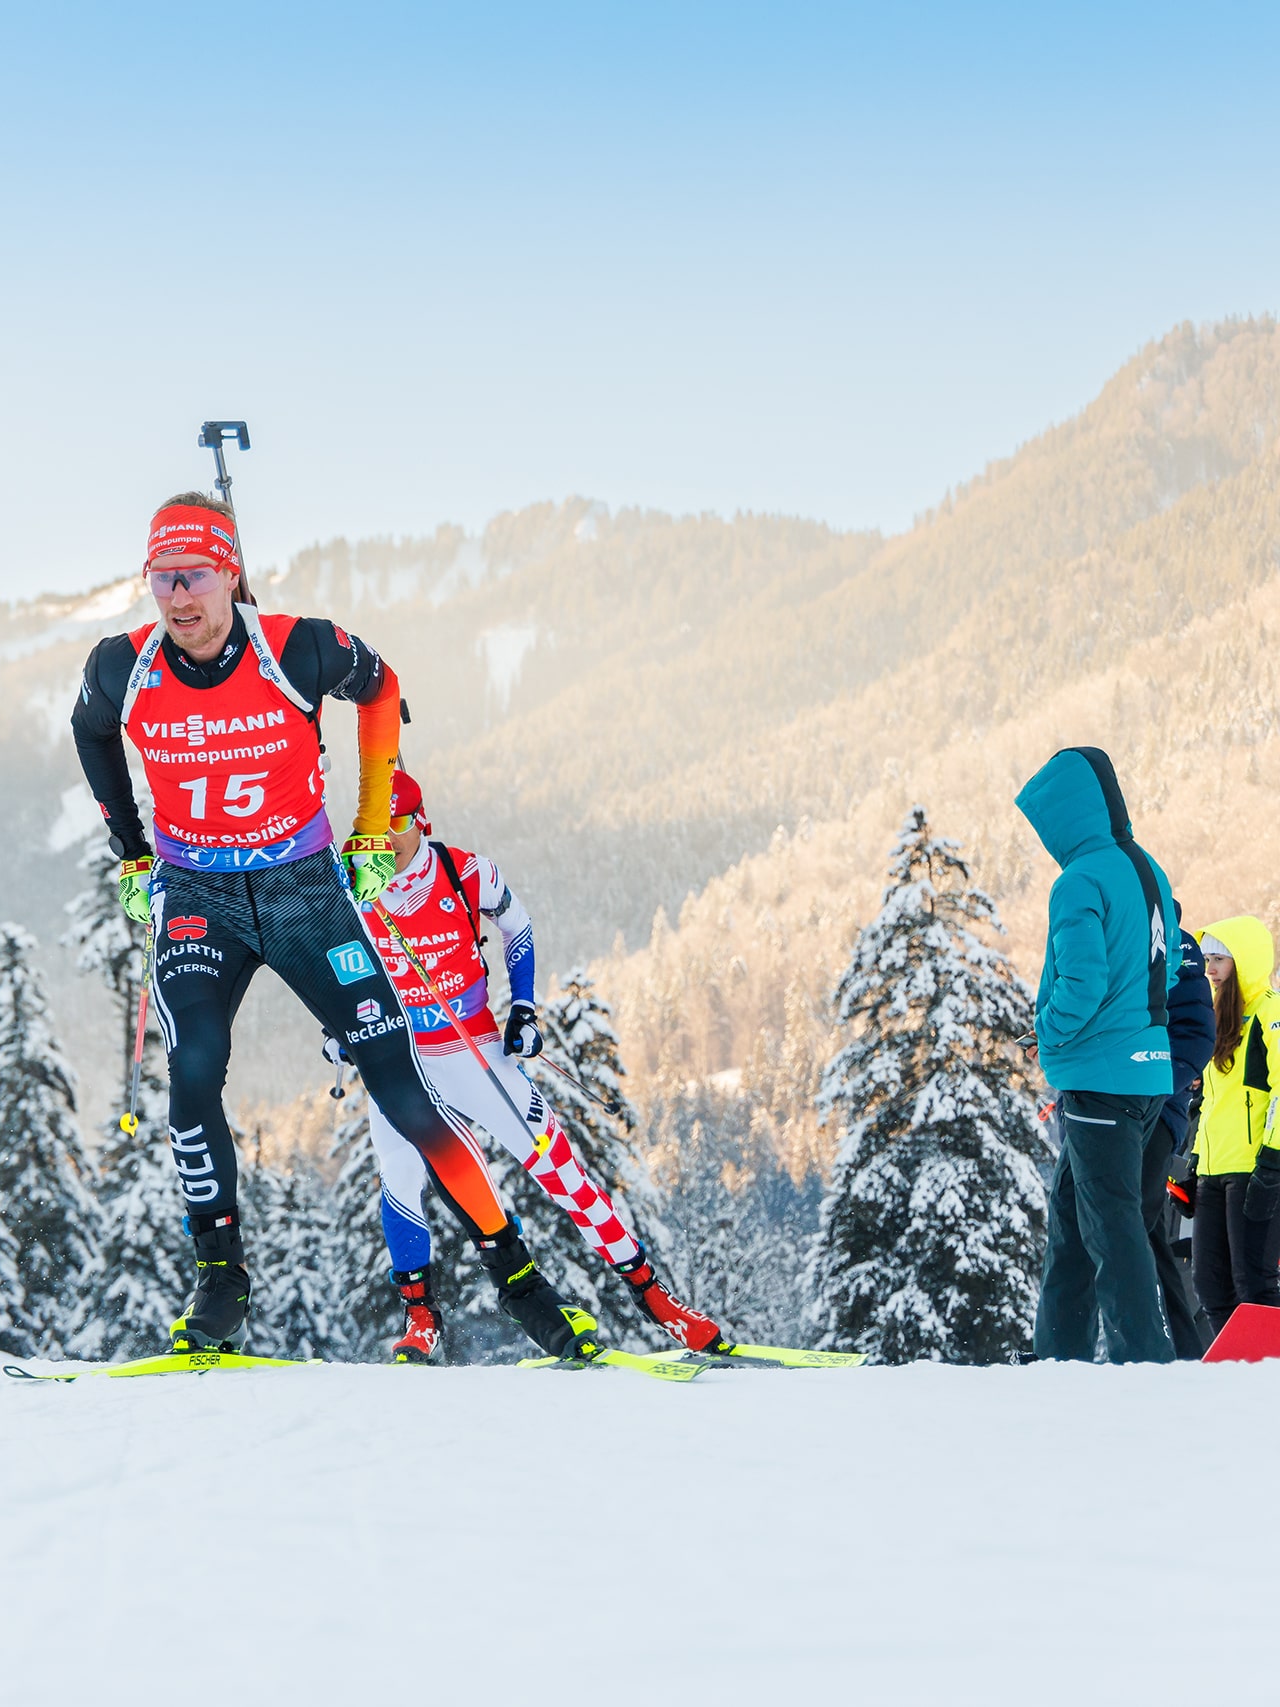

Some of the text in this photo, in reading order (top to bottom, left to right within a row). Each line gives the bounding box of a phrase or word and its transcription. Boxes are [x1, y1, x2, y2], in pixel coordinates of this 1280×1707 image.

[130, 639, 159, 689] SENFTL OHG
[268, 668, 280, 683] OHG
[141, 709, 286, 747] VIESSMANN
[143, 738, 288, 764] Wärmepumpen
[178, 770, 269, 820] 15
[157, 943, 223, 966] WÜRTH
[334, 947, 370, 974] TQ
[175, 963, 219, 978] TERREX
[345, 1015, 405, 1044] tectake
[169, 1124, 219, 1202] GER
[189, 1354, 221, 1366] FISCHER
